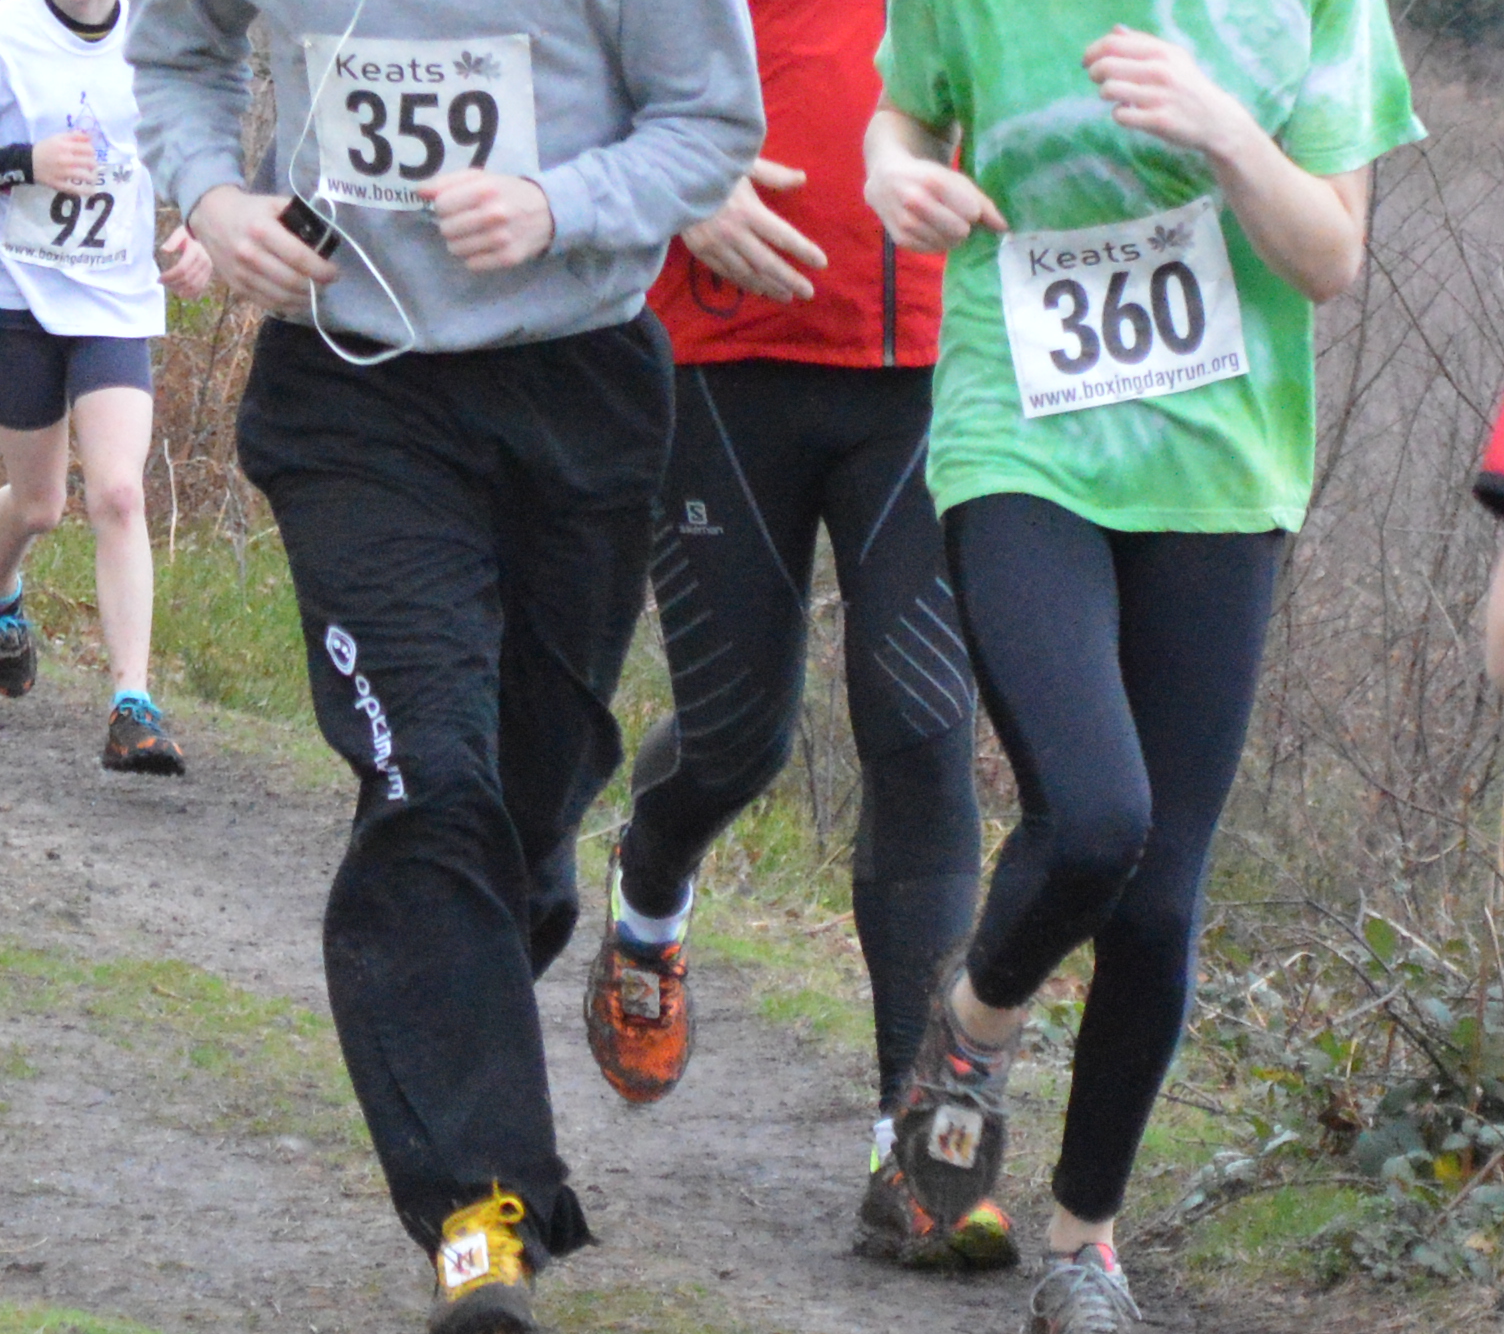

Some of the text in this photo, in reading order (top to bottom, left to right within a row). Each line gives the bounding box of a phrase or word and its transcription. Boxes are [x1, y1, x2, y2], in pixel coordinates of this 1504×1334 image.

[336, 53, 445, 83] Keats
[345, 89, 500, 180] 359
[50, 191, 115, 249] 92
[1028, 240, 1142, 276] Keats
[1042, 260, 1206, 375] 360
[1029, 351, 1240, 409] www.boxingdayrun.org
